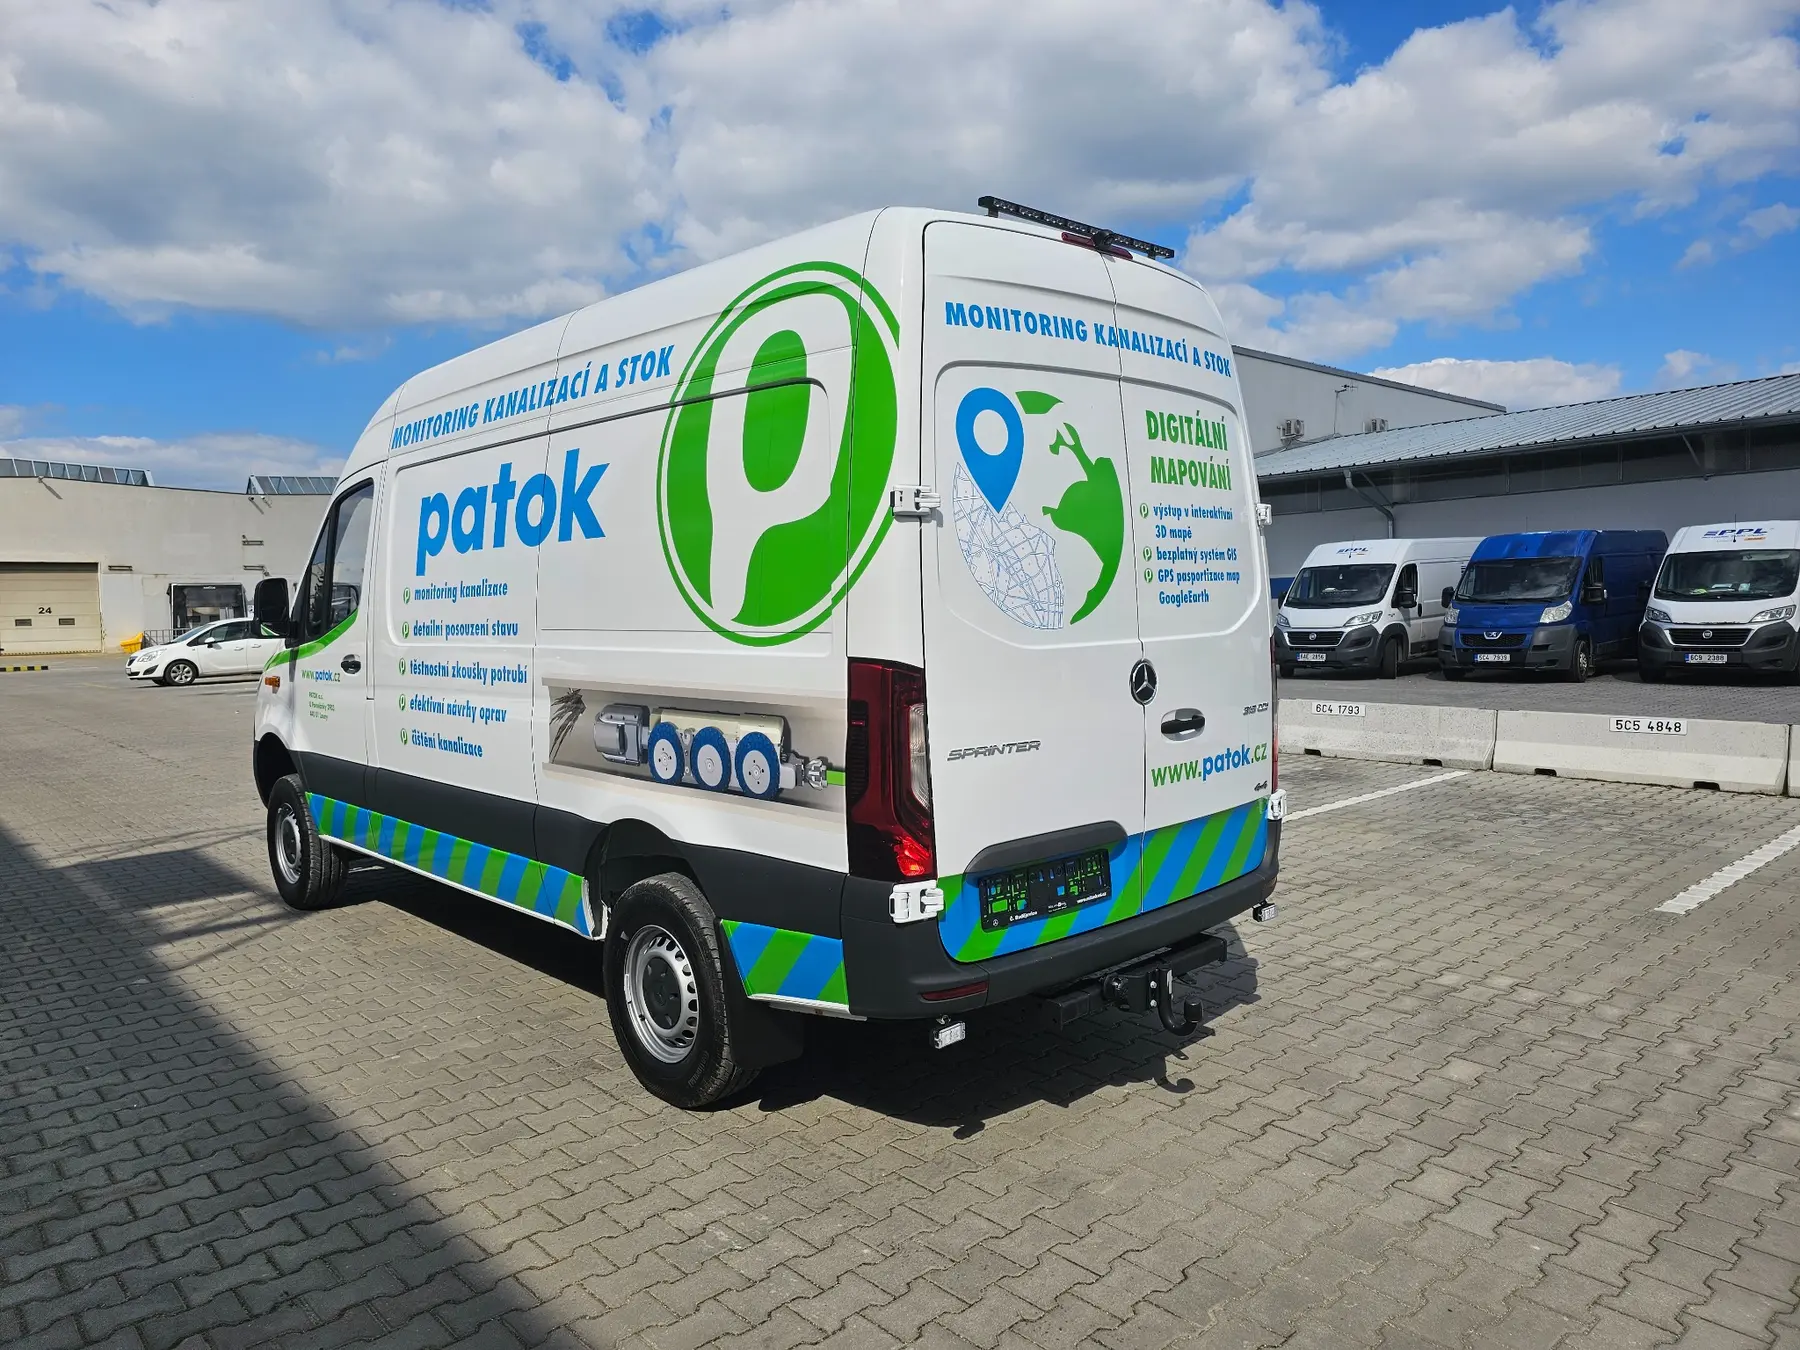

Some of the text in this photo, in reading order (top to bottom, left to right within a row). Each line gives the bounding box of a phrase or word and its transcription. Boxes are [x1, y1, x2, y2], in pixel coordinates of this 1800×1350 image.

[945, 302, 1231, 378] MONITORING KANALIZACÍ A STOK
[391, 344, 675, 449] MONITORING KANALIZACÍ A STOK
[1145, 410, 1228, 451] DIGITÁLNÍ
[1150, 456, 1232, 491] MAPOVÁNÍ
[416, 448, 610, 576] patok
[1153, 503, 1182, 521] výstup
[1184, 507, 1189, 517] v
[1155, 525, 1192, 541] 3D mapě
[1718, 528, 1768, 536] PPL
[1156, 545, 1238, 564] bezplatný systém GIS
[1158, 568, 1240, 585] GPS pasportizace map
[414, 578, 508, 603] monitoring kanalizace
[1159, 590, 1210, 607] GoogleEarth
[38, 606, 52, 614] 24
[413, 618, 518, 641] detailní posouzení stavu
[301, 669, 340, 682] www.patok.cz
[410, 659, 528, 686] těstnostní zkoušky potrubí
[410, 694, 507, 725] efektivní návrhy oprav
[1315, 703, 1360, 715] 6C4 1793
[1615, 719, 1682, 732] 5C5 4848
[411, 729, 483, 757] čištění kanalizace
[946, 740, 1041, 761] SPRINTER
[1151, 742, 1267, 788] www.patok.cz
